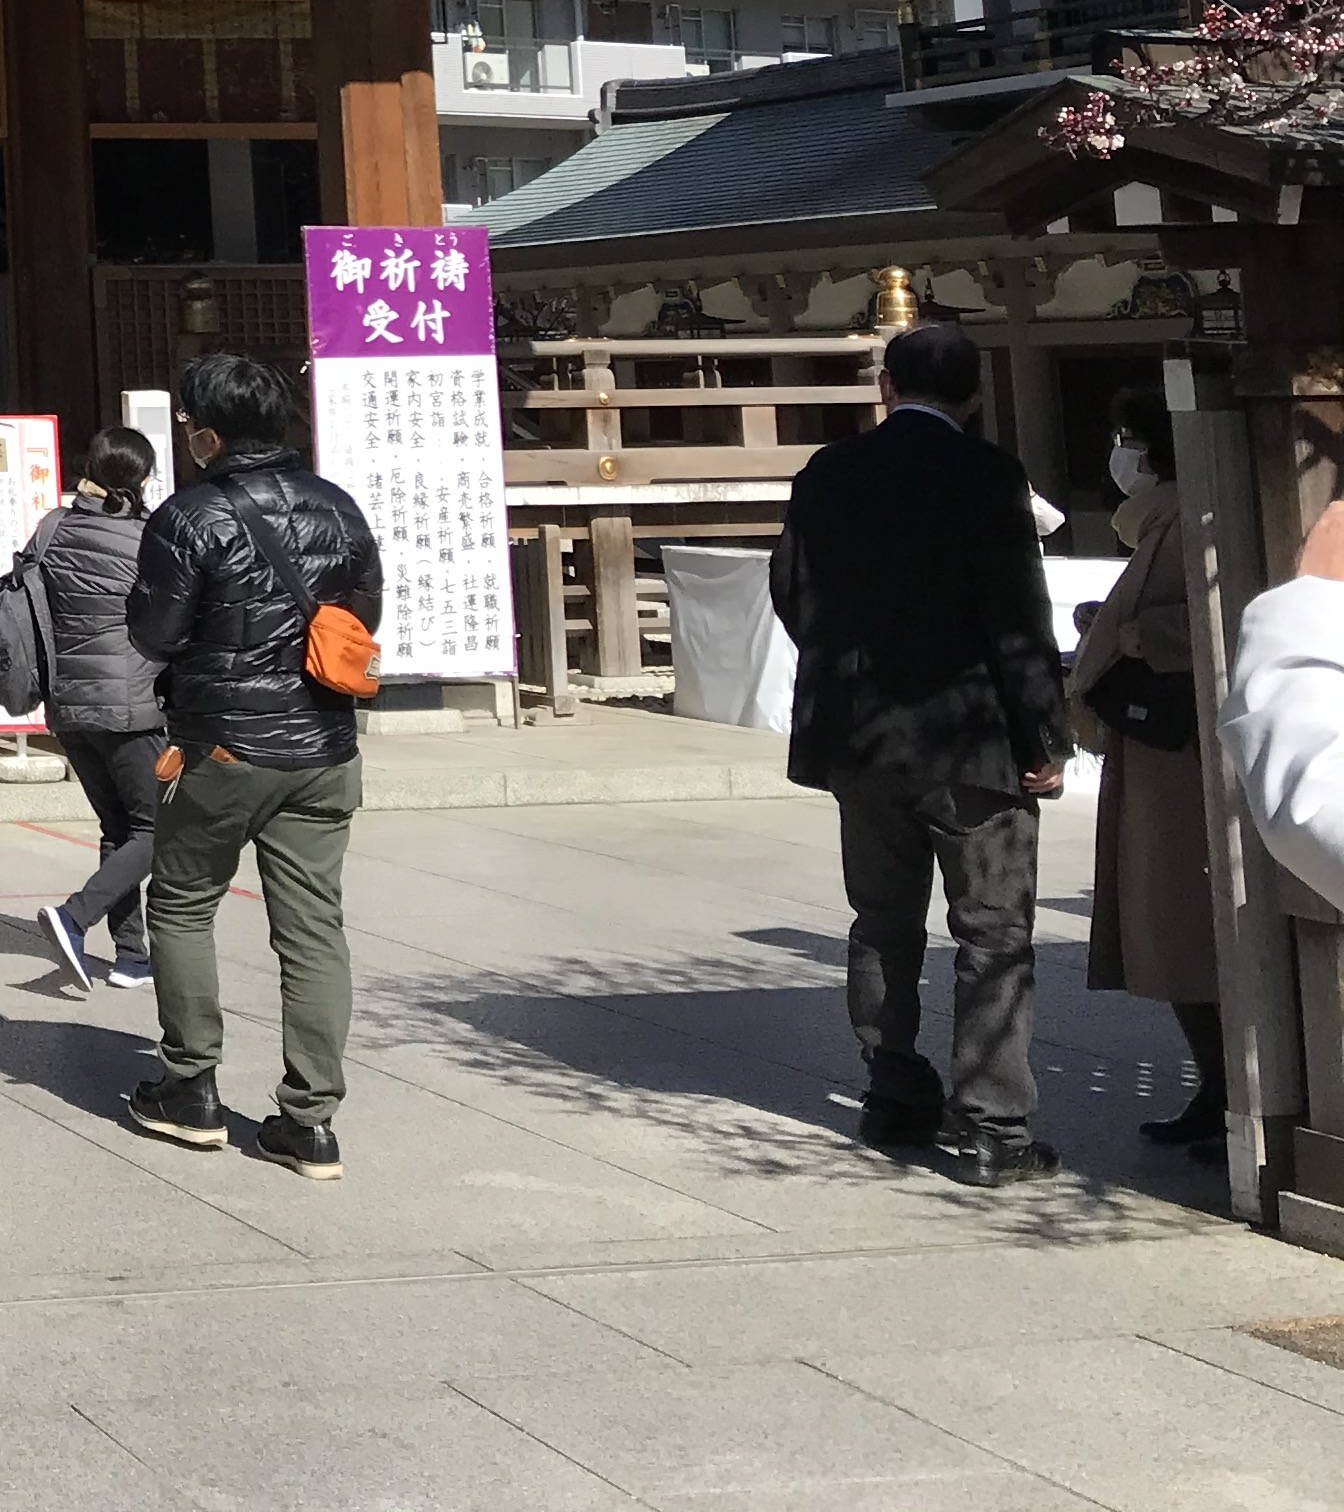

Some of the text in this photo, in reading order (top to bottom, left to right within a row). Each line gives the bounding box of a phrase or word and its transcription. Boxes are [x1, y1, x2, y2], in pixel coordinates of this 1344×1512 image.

[330, 248, 470, 294] 御祈祷
[363, 299, 451, 345] 受付
